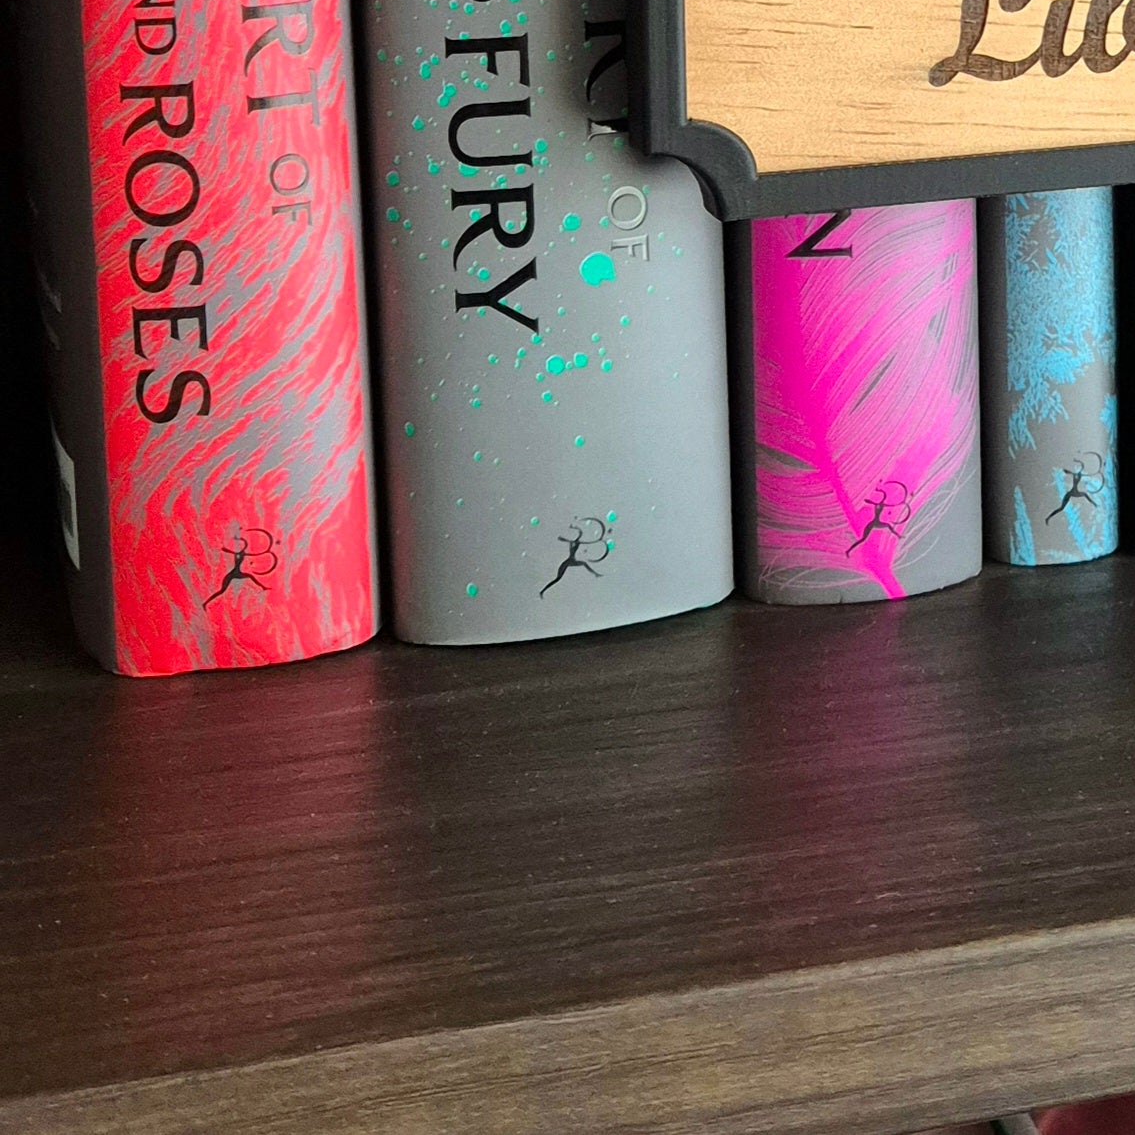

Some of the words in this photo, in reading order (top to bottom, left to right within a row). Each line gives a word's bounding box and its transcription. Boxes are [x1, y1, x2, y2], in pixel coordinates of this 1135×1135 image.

[120, 82, 211, 424] ROSES
[269, 152, 313, 226] OF
[445, 32, 539, 335] FURY
[607, 186, 650, 262] OF
